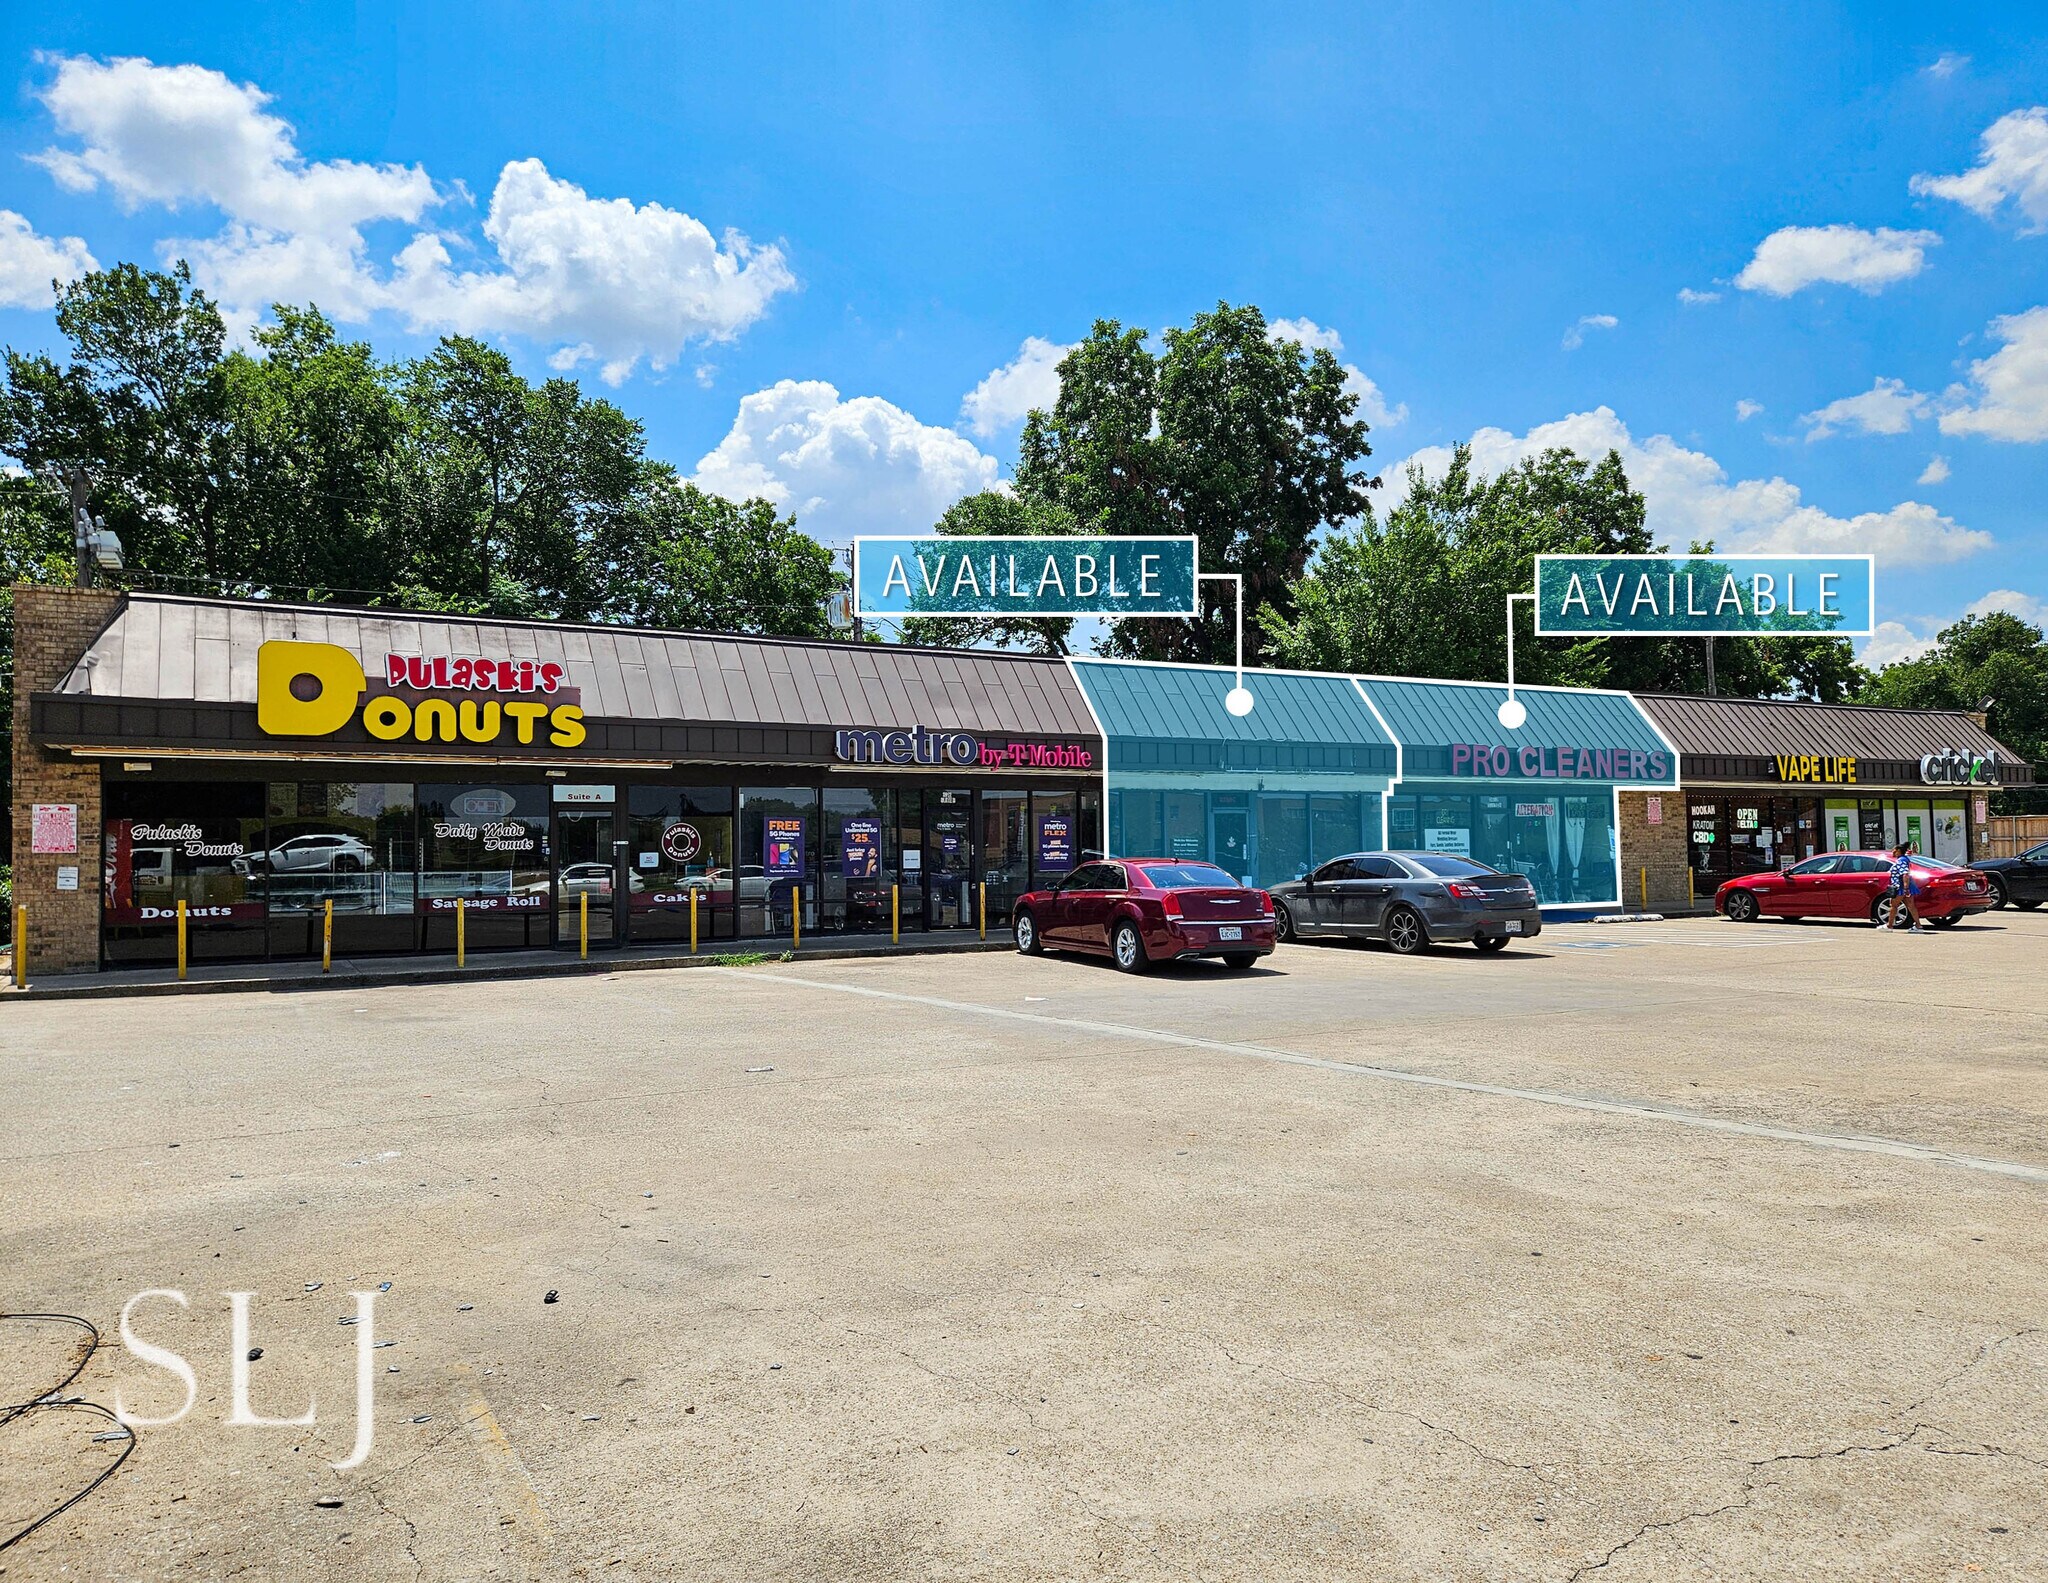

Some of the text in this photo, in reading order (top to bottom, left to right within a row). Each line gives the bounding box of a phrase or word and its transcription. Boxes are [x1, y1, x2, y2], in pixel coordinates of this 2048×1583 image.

[836, 724, 978, 765] metro
[978, 742, 1004, 772] by
[1452, 743, 1668, 780] PRO CLEANERS
[1920, 748, 2002, 786] cricket
[1777, 755, 1857, 783] VAPE LIFE
[1691, 805, 1716, 816] HOOKAH
[1736, 808, 1758, 820] OPEN
[434, 822, 525, 840] Daily Made
[769, 820, 800, 830] FREE
[1692, 820, 1715, 830] KRATOM
[131, 824, 202, 841] Pulaskis
[665, 827, 696, 840] Pulaskis
[851, 833, 869, 843] $25
[1693, 831, 1709, 844] CBD
[1835, 830, 1848, 838] FREE
[184, 841, 244, 857] Donuts
[483, 836, 534, 851] Donuts
[667, 846, 695, 858] Donuts
[506, 896, 541, 906] Roll
